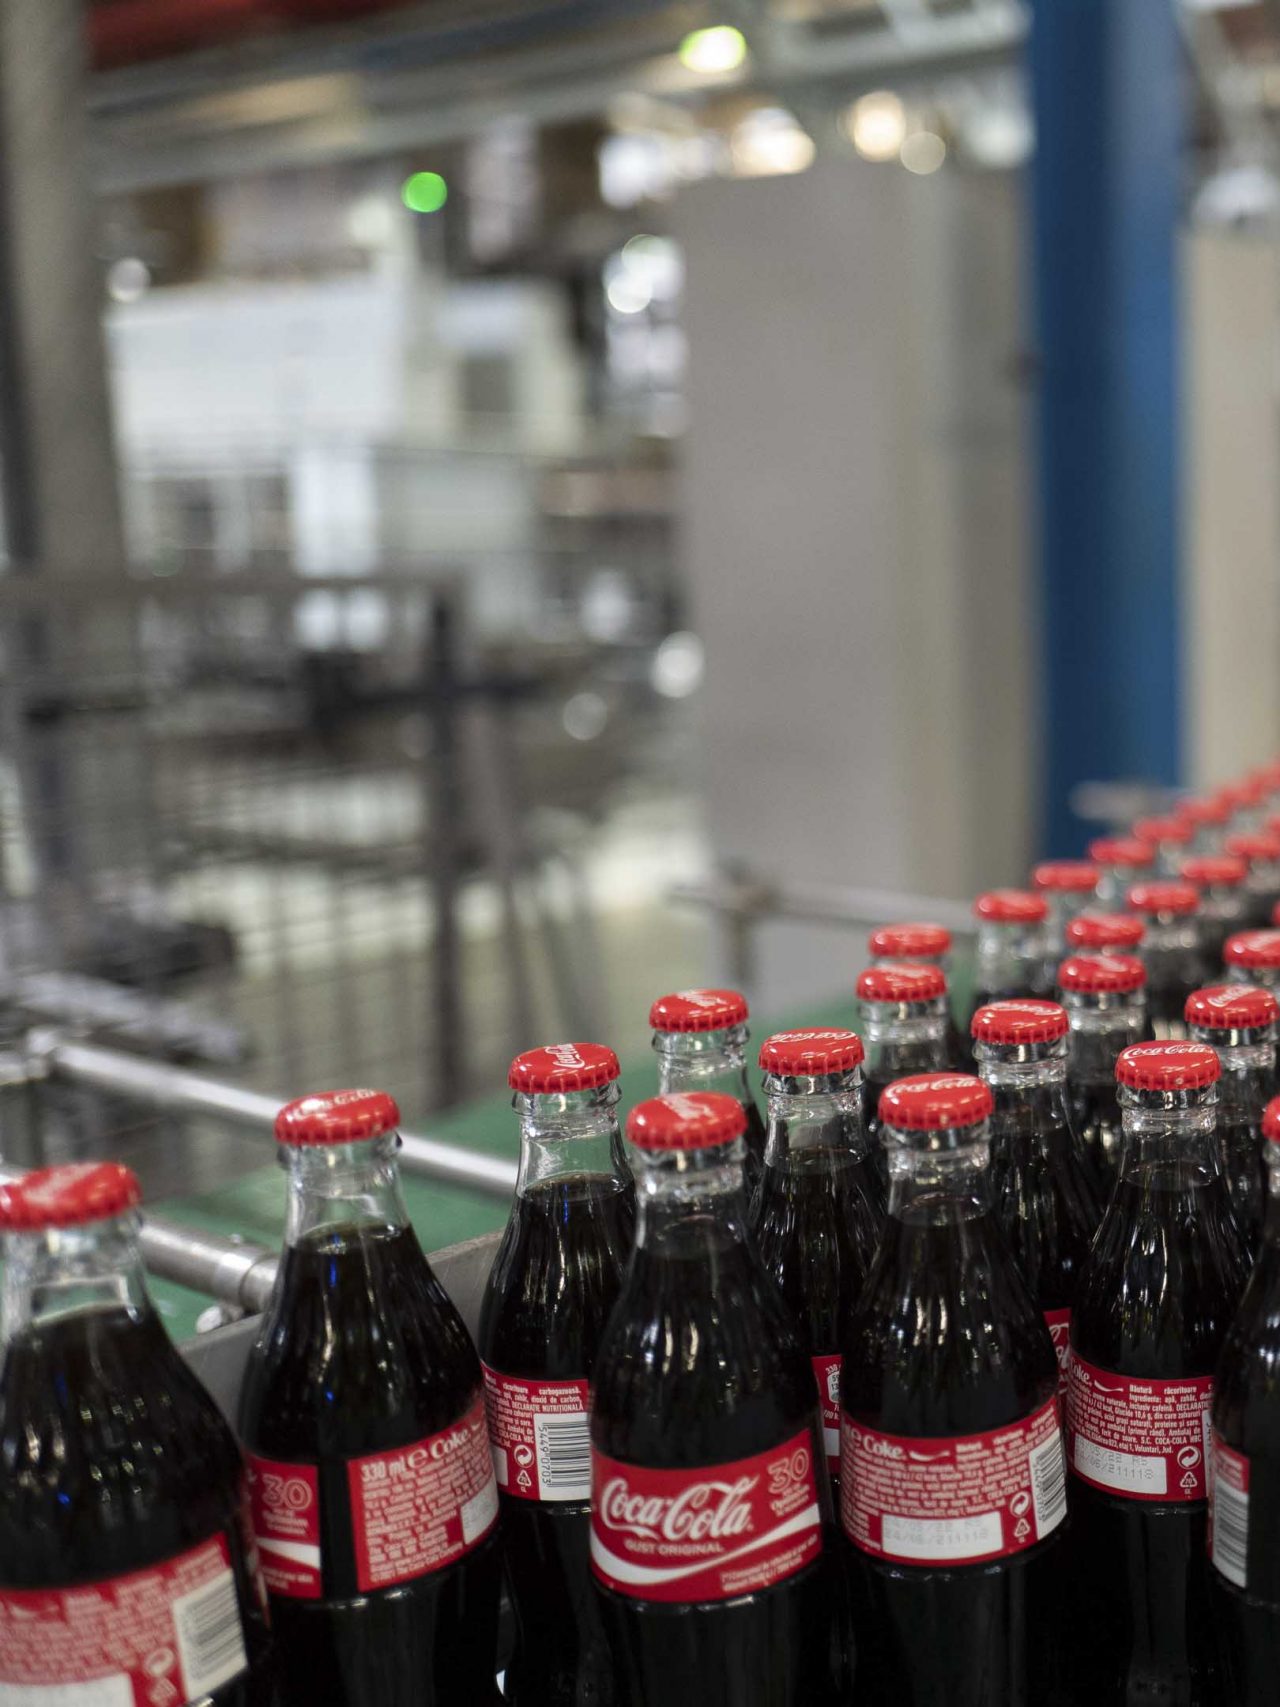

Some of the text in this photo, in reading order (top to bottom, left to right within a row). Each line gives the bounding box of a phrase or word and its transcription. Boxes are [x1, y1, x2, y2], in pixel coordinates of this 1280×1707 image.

[1122, 1044, 1213, 1061] Coca-Cola
[885, 1077, 979, 1099] Coca-Cola
[430, 1428, 470, 1461] Coke
[1155, 1436, 1187, 1446] COCA-COLA
[767, 1447, 810, 1495] 30
[600, 1473, 760, 1541] Coca-Cola
[624, 1538, 724, 1556] GUST ORIGINAL
